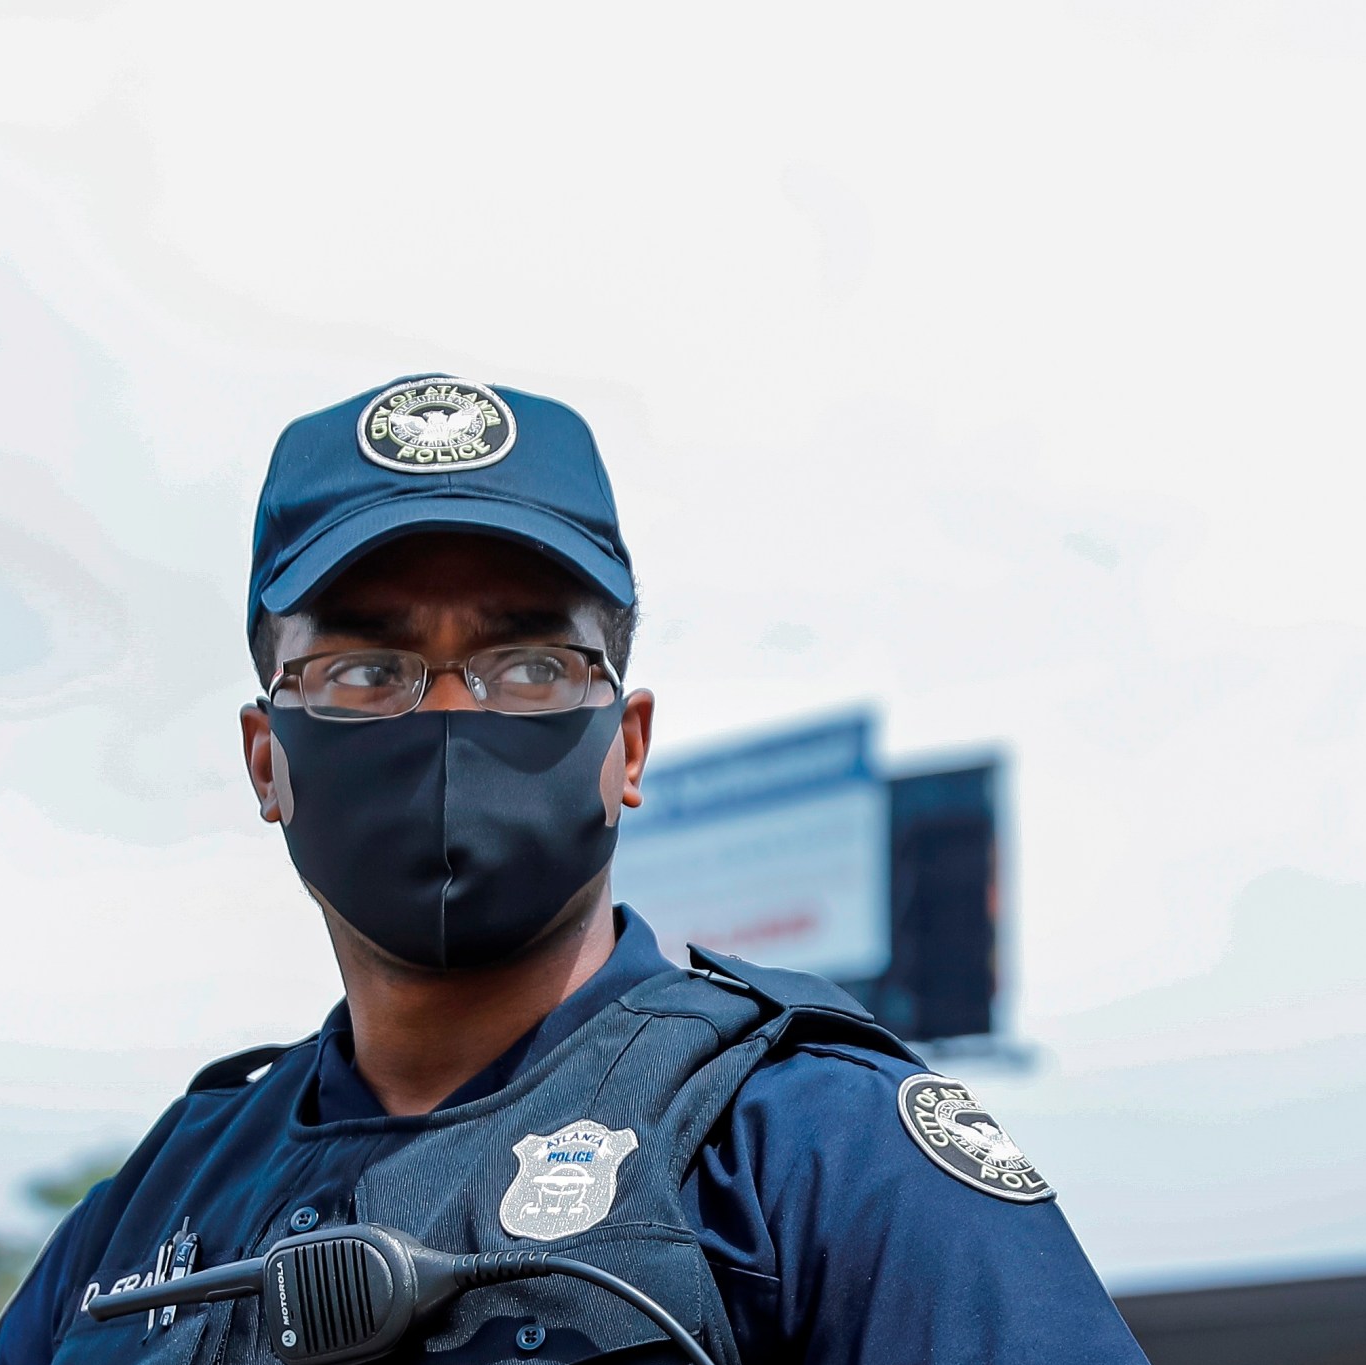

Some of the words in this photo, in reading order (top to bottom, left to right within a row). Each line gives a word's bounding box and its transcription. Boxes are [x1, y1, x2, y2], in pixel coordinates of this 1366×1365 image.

[371, 407, 392, 440] CITY
[390, 389, 417, 408] OF
[424, 385, 502, 427] ATLANTA
[397, 438, 491, 463] POLICE
[915, 1087, 939, 1107] OF
[913, 1105, 950, 1148] CITY
[546, 1132, 604, 1149] ATLANTA
[547, 1151, 595, 1163] POLICE
[276, 1261, 290, 1326] MOTOROLA
